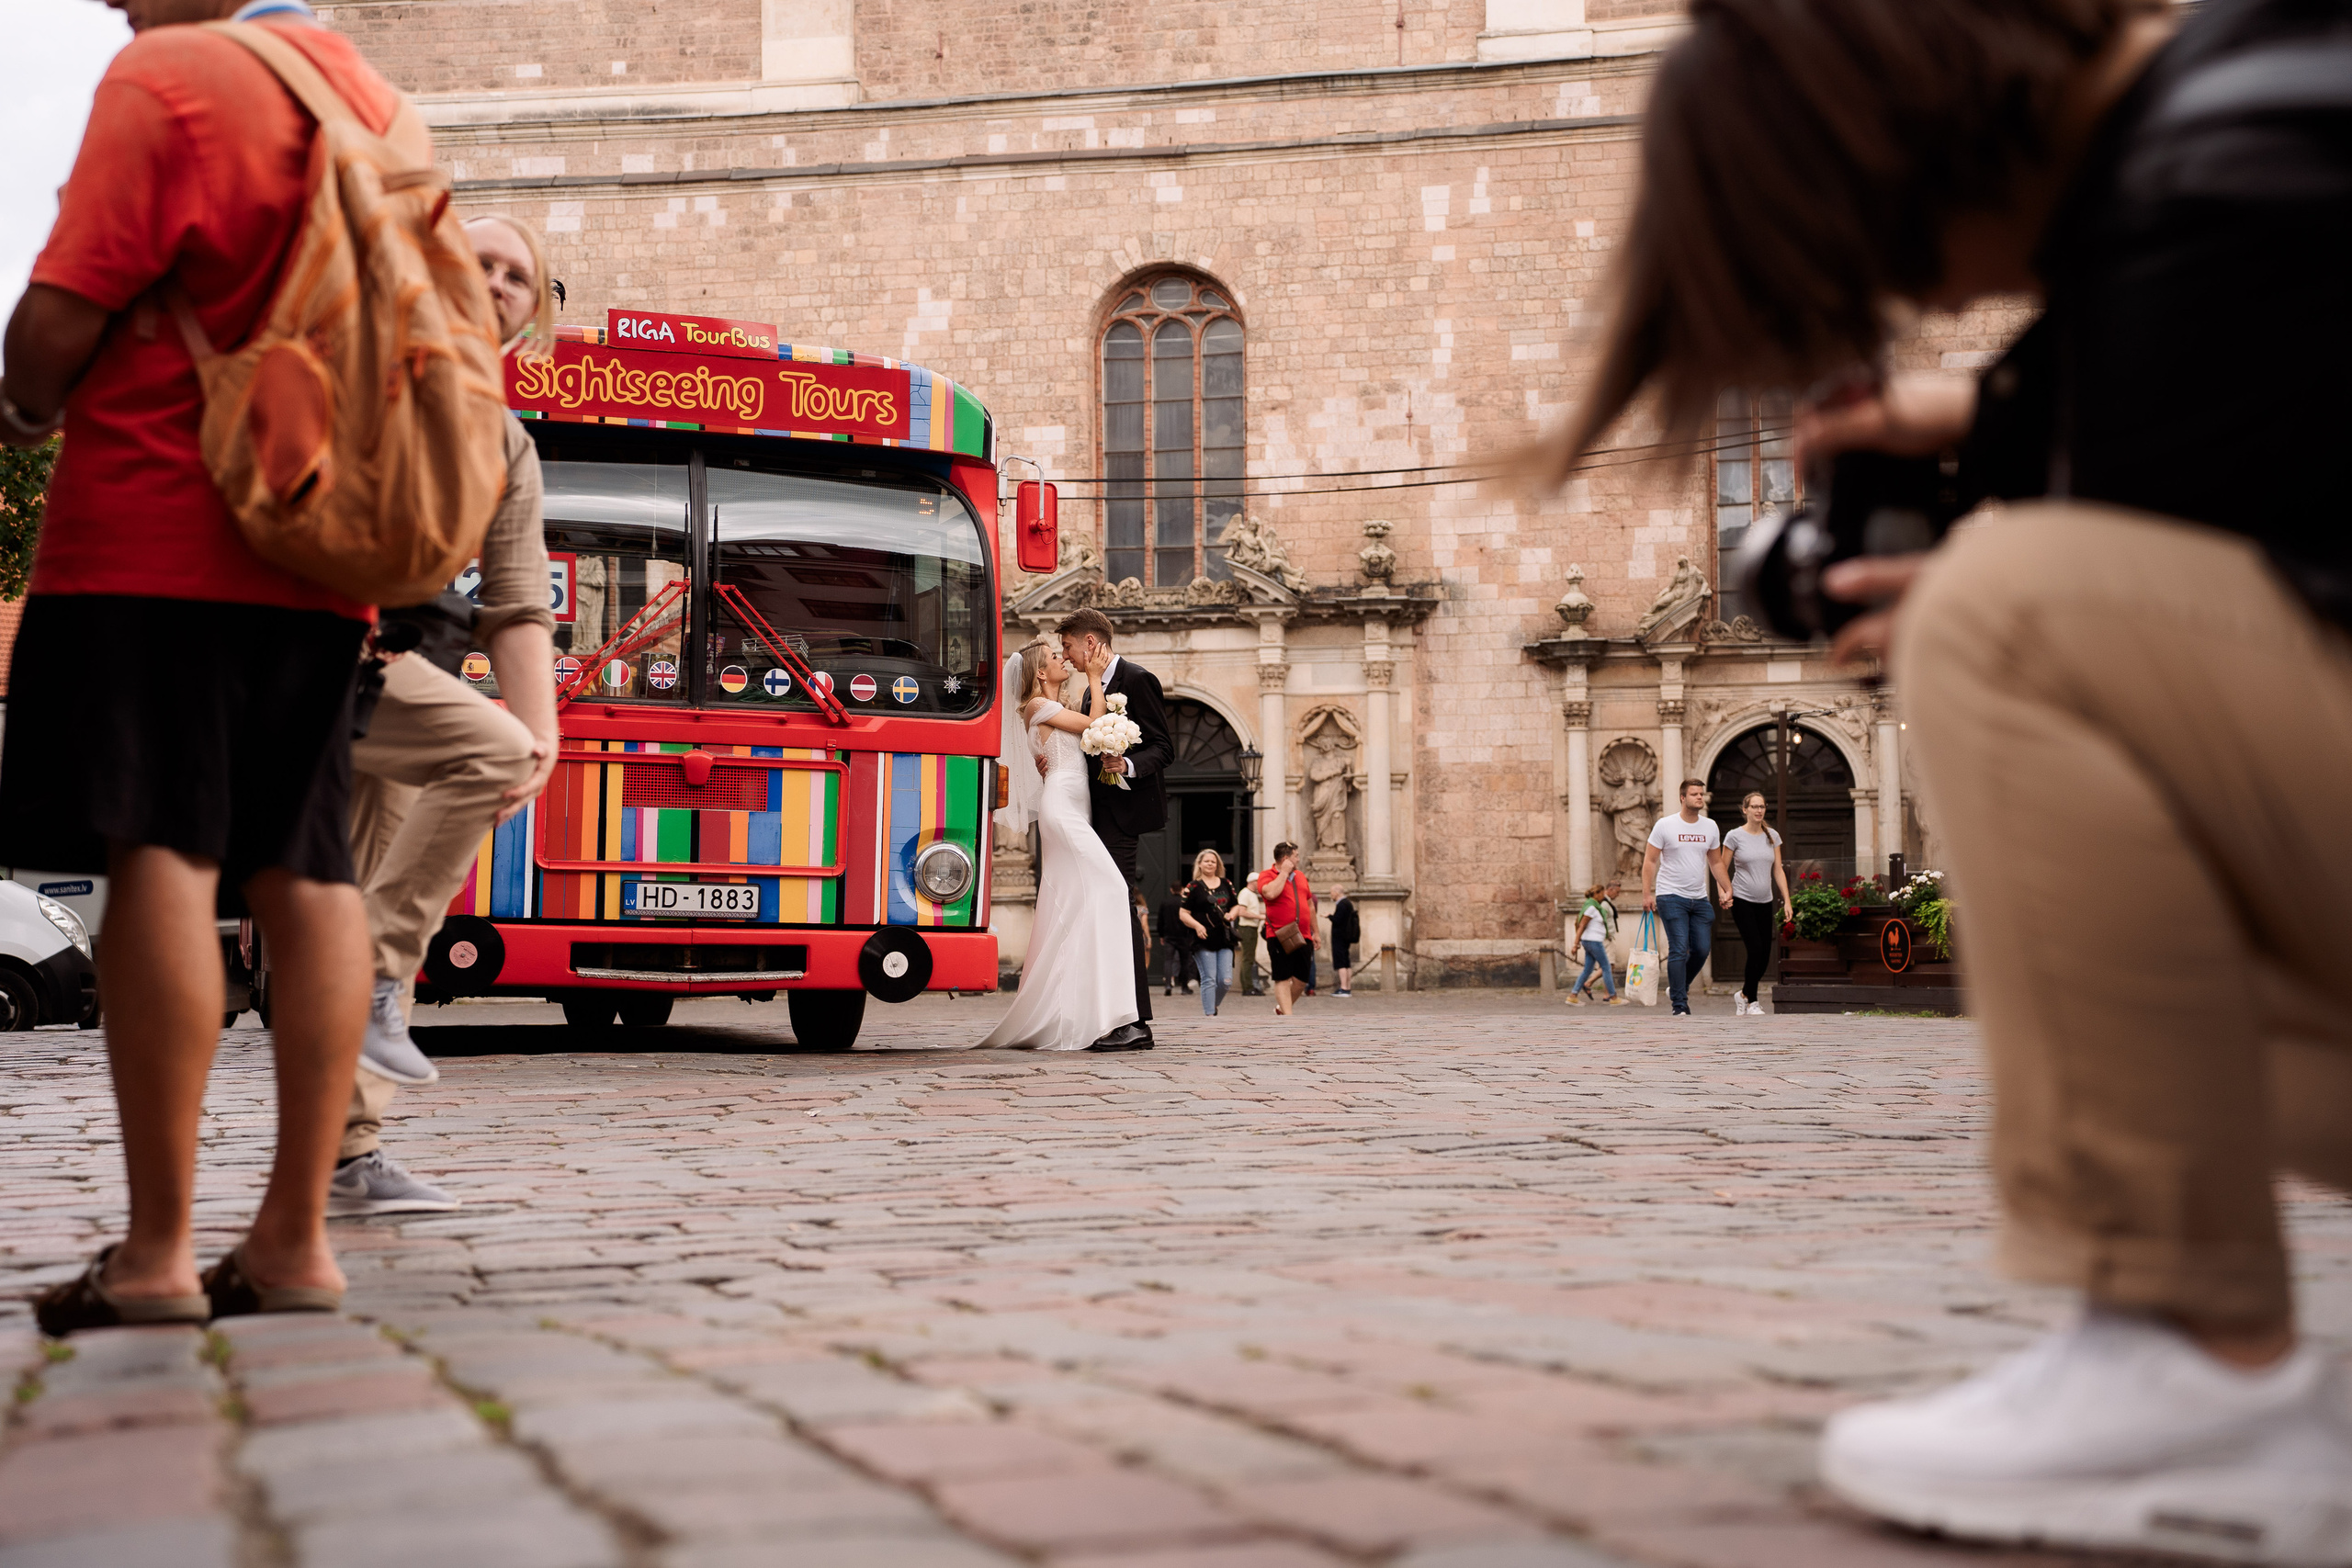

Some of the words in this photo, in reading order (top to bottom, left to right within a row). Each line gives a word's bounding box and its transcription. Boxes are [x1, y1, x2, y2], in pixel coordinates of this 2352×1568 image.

[616, 317, 675, 344] RIGA
[680, 321, 771, 349] TourBus
[515, 350, 764, 421] Sightseeing
[779, 371, 898, 425] Tours
